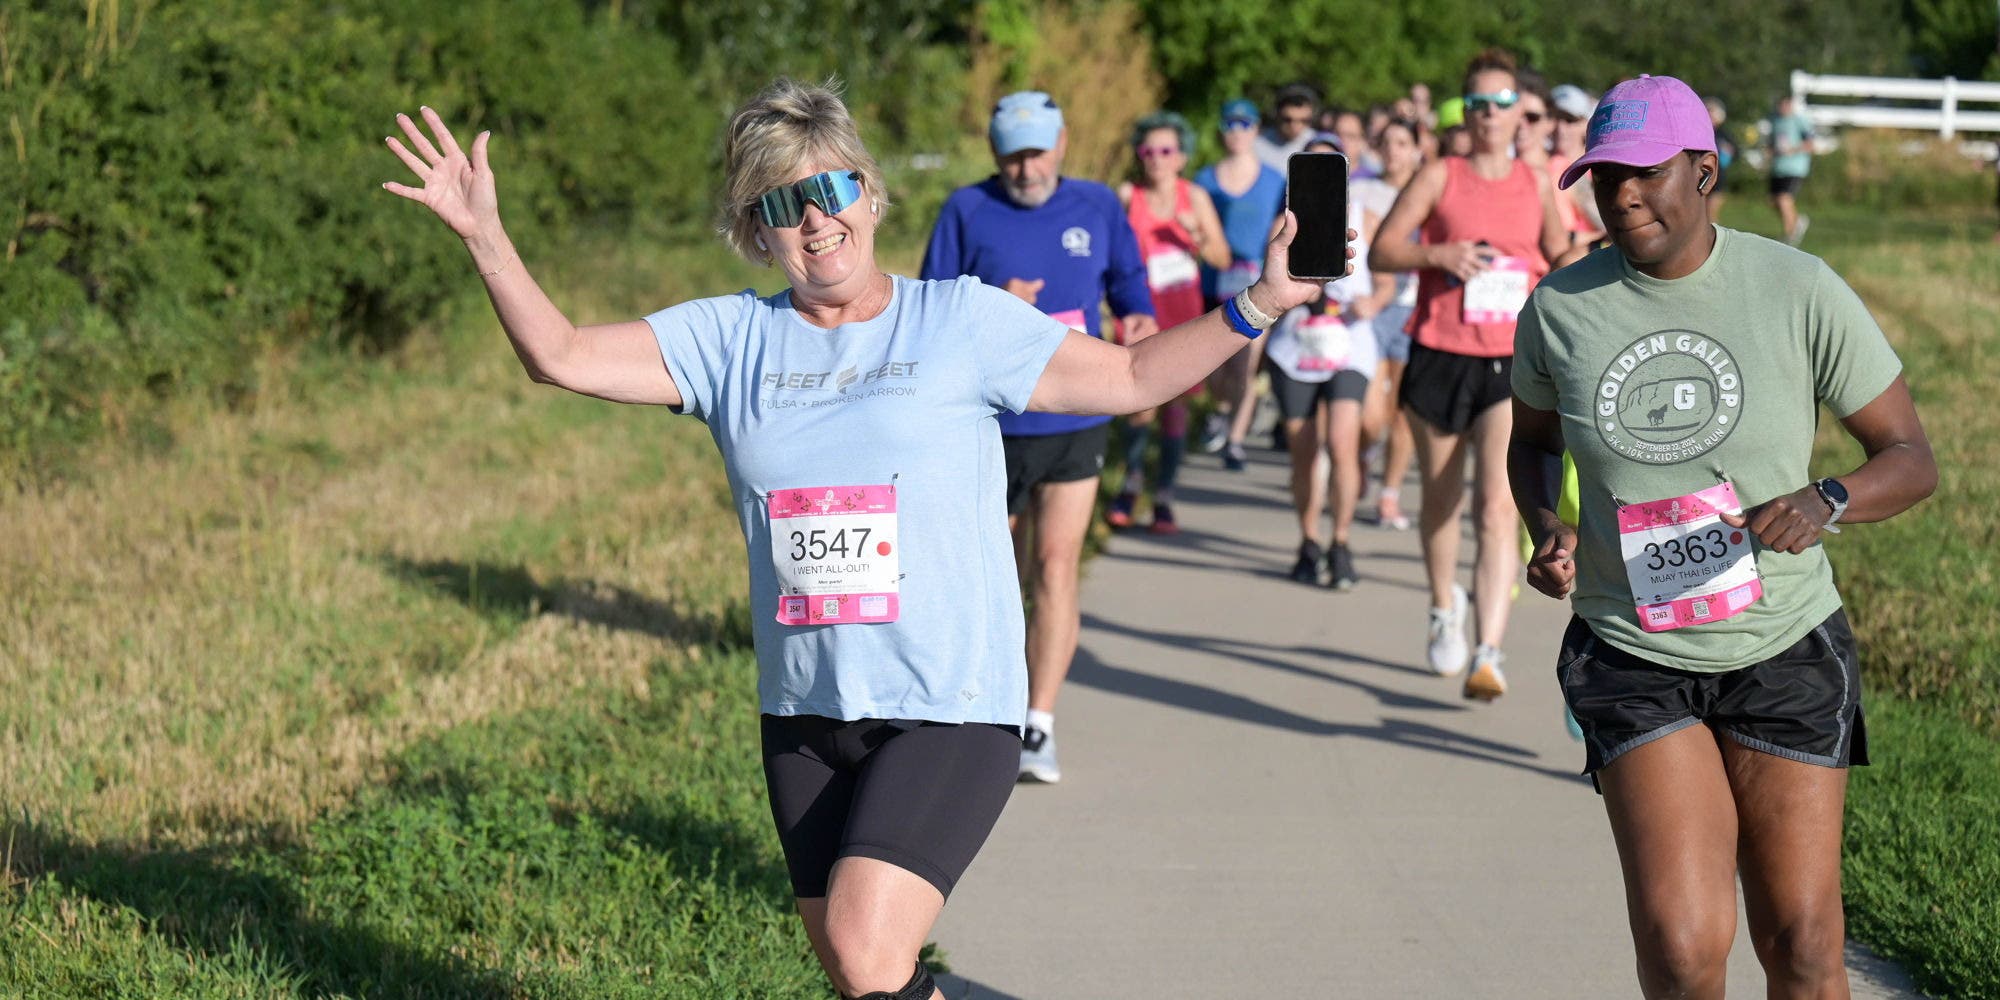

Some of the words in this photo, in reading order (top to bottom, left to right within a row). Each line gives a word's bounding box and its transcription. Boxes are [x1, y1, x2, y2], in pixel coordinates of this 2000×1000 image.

[761, 371, 831, 389] FLEET
[1599, 335, 1667, 417] GOLDEN
[1675, 335, 1738, 408] GALLOP
[760, 398, 798, 409] TULSA
[811, 393, 864, 408] BROKEN
[868, 386, 917, 398] ARROW
[1673, 383, 1696, 410] G
[1608, 435, 1621, 448] 5K
[1626, 446, 1643, 460] 10K
[1654, 452, 1679, 461] KIDS
[1682, 443, 1704, 458] FUN
[1704, 428, 1725, 446] RUN
[1635, 440, 1670, 452] SEPTEMBER
[1681, 438, 1696, 450] 2024
[790, 527, 872, 562] 3547
[1644, 529, 1728, 571] 3363
[797, 565, 824, 575] WENT
[825, 563, 870, 574] ALL-OUT!
[1650, 572, 1676, 584] MUAY
[1679, 568, 1699, 580] THAI
[1701, 567, 1711, 576] IS
[1713, 560, 1733, 573] LIFE
[789, 604, 801, 613] 3547
[1651, 611, 1668, 621] 3363
